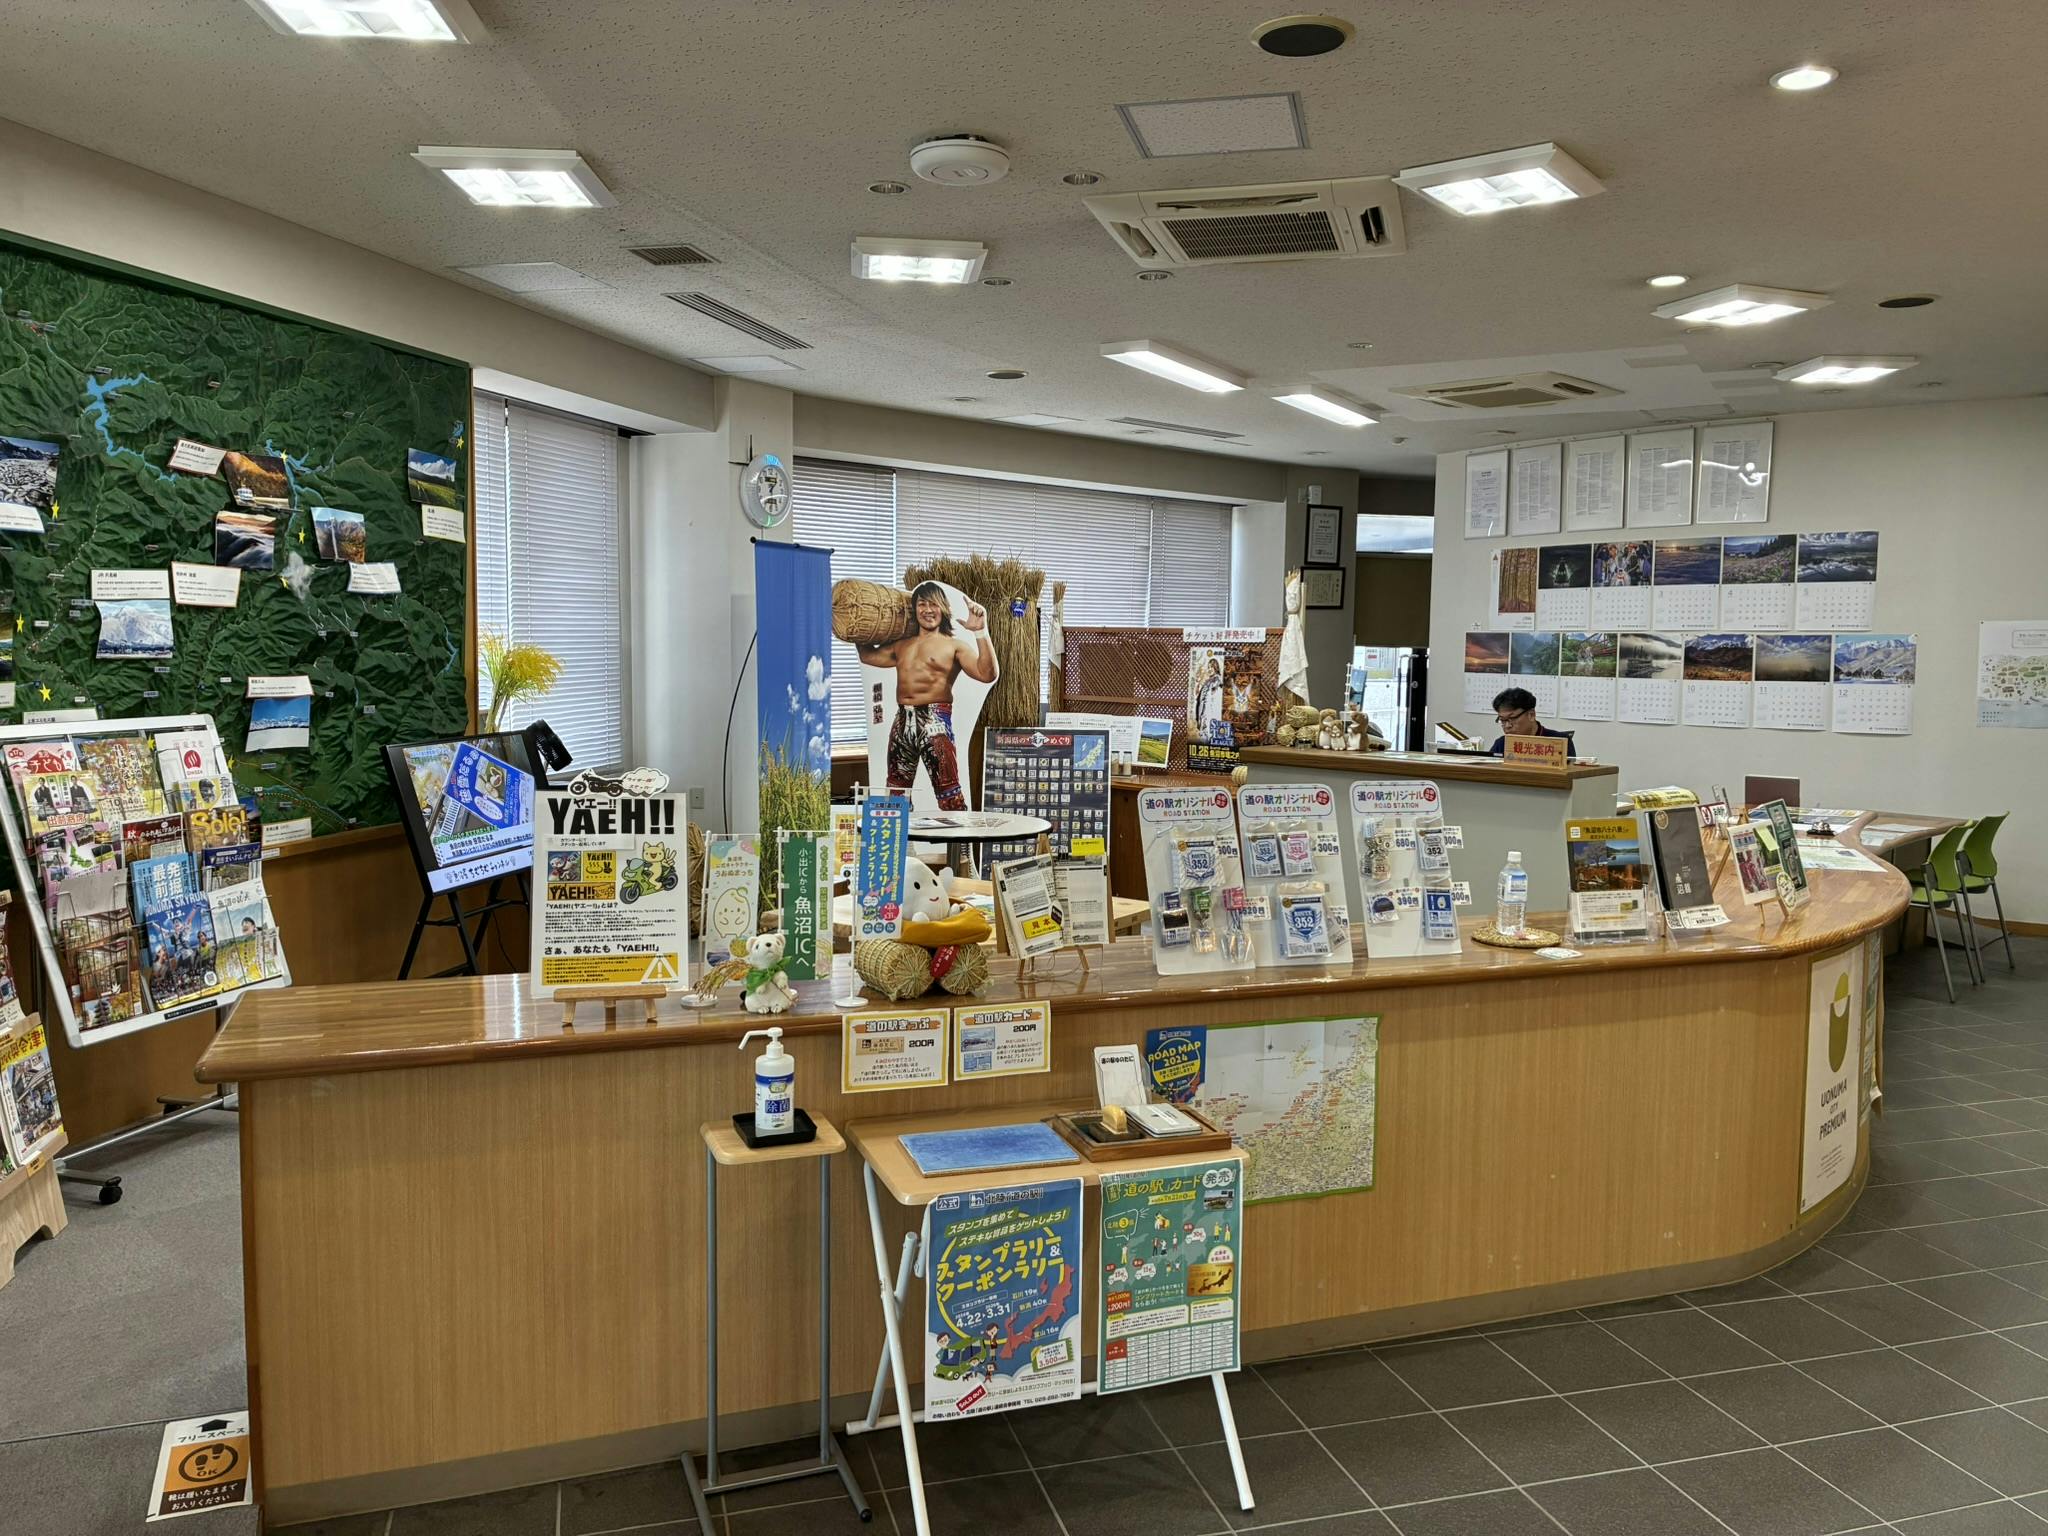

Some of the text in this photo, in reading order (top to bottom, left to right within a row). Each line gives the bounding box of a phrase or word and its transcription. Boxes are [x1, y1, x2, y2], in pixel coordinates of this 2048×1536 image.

[1513, 741, 1555, 755] 観光案内
[1245, 794, 1316, 806] 道の駅オリジナル
[1357, 790, 1423, 802] 道の駅オリジナル
[574, 799, 616, 808] ヤエー!!
[1145, 796, 1215, 810] 道の駅オリジナル
[547, 798, 675, 834] YAEH!!
[1396, 838, 1416, 848] 680円
[1444, 836, 1462, 845] 300円
[1318, 843, 1339, 852] 300円
[1427, 847, 1441, 855] 352
[1192, 859, 1208, 870] 352
[1451, 892, 1470, 901] 300円
[1294, 915, 1314, 928] 352
[974, 1009, 1033, 1024] 道の駅カード
[865, 1017, 931, 1032] 道の駅きっぷ
[1013, 1024, 1037, 1032] 200円
[908, 1039, 935, 1048] 200円
[1148, 1041, 1201, 1062] ROAD MAP
[1164, 1054, 1188, 1067] 2024
[1820, 1078, 1847, 1108] UONUMA
[1819, 1109, 1847, 1140] PREMIUM
[938, 1198, 959, 1209] 公式
[948, 1209, 1015, 1236] スタンプを集めて
[936, 1236, 1062, 1283] スタンプラリー &
[937, 1256, 1064, 1302] クーポンラリー
[956, 1303, 1011, 1329] 4.22 3.31
[177, 1427, 246, 1443] フリースペース
[196, 1468, 218, 1477] OK
[171, 1494, 231, 1511] お入りください
